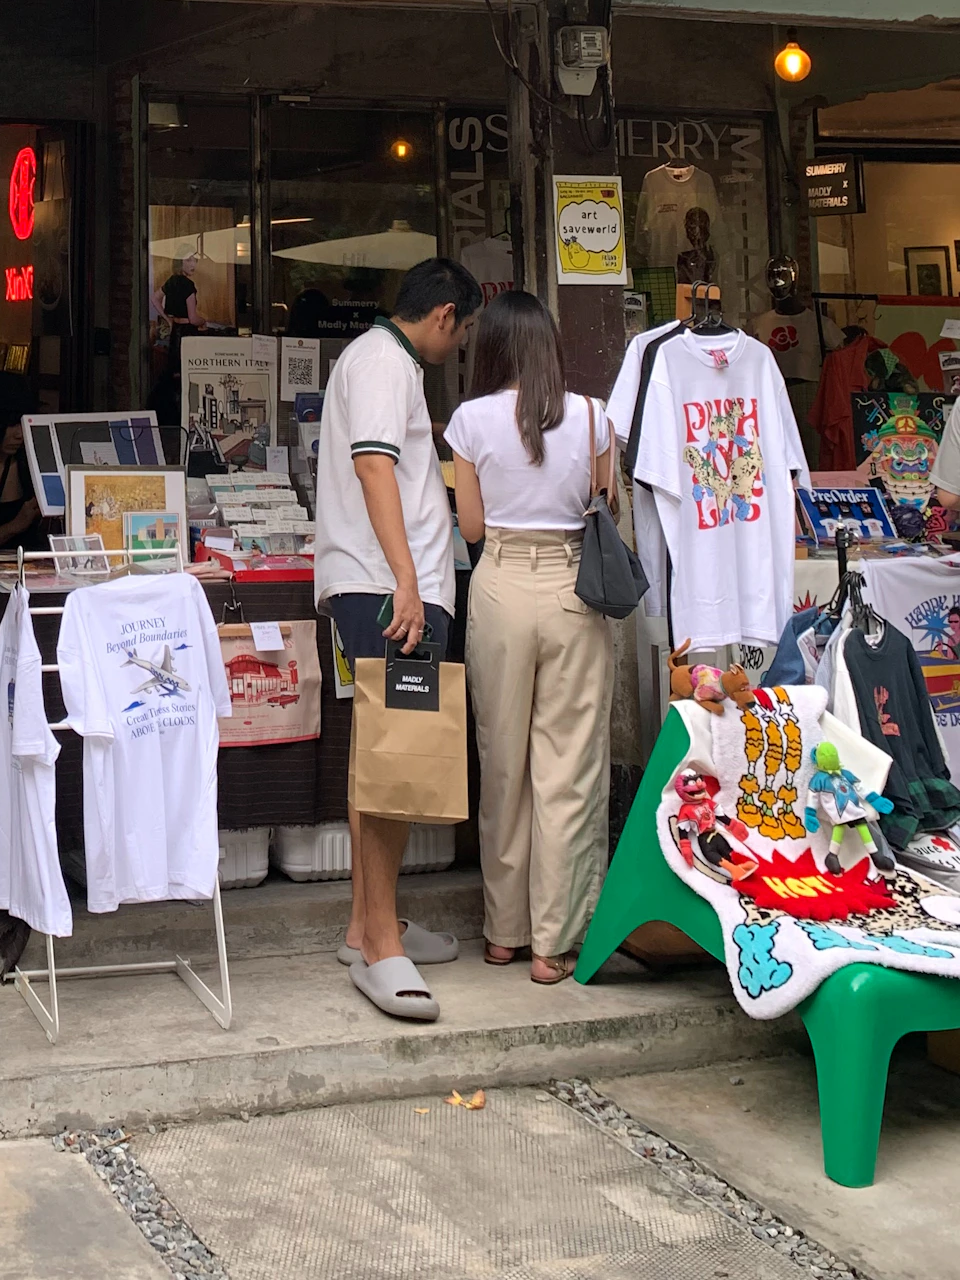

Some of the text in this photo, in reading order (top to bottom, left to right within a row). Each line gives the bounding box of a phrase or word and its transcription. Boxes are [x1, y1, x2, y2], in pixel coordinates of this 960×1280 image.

[805, 162, 847, 177] SUMMERRY
[807, 186, 833, 198] MADLY
[808, 196, 849, 208] MATERIALS
[581, 211, 598, 220] art
[563, 223, 617, 233] saveworld
[331, 298, 380, 310] Summerry
[318, 320, 348, 331] Madly
[188, 358, 269, 367] NORTHERN ITALY
[808, 489, 869, 504] PreOrder
[904, 594, 949, 628] HAPPY
[120, 616, 167, 636] JOURNEY
[106, 628, 188, 654] Beyond Boundaries
[401, 675, 424, 683] MADLY
[395, 683, 430, 693] MATERIALS
[761, 875, 844, 899] HOT!
